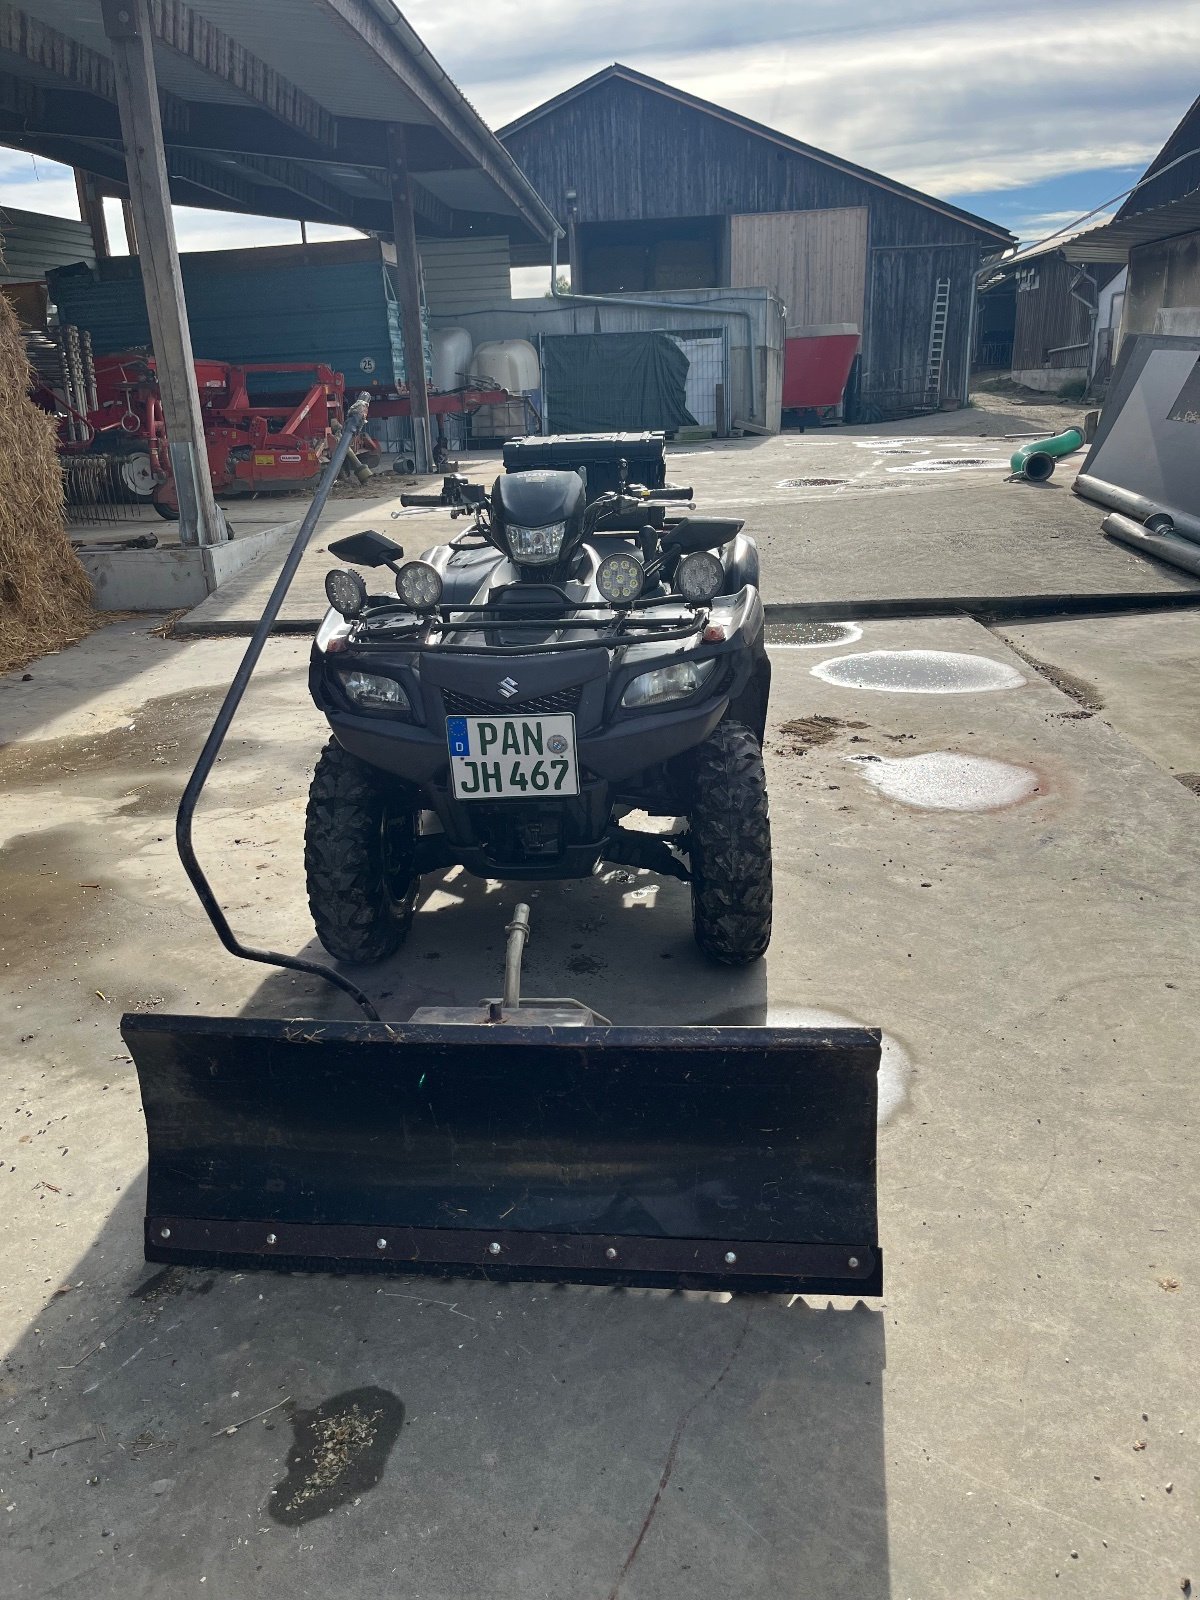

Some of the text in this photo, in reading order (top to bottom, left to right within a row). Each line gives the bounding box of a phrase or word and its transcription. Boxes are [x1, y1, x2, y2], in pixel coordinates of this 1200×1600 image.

[362, 360, 373, 370] 25
[455, 741, 464, 752] D
[477, 721, 544, 756] PAN
[460, 760, 569, 793] JH 467
